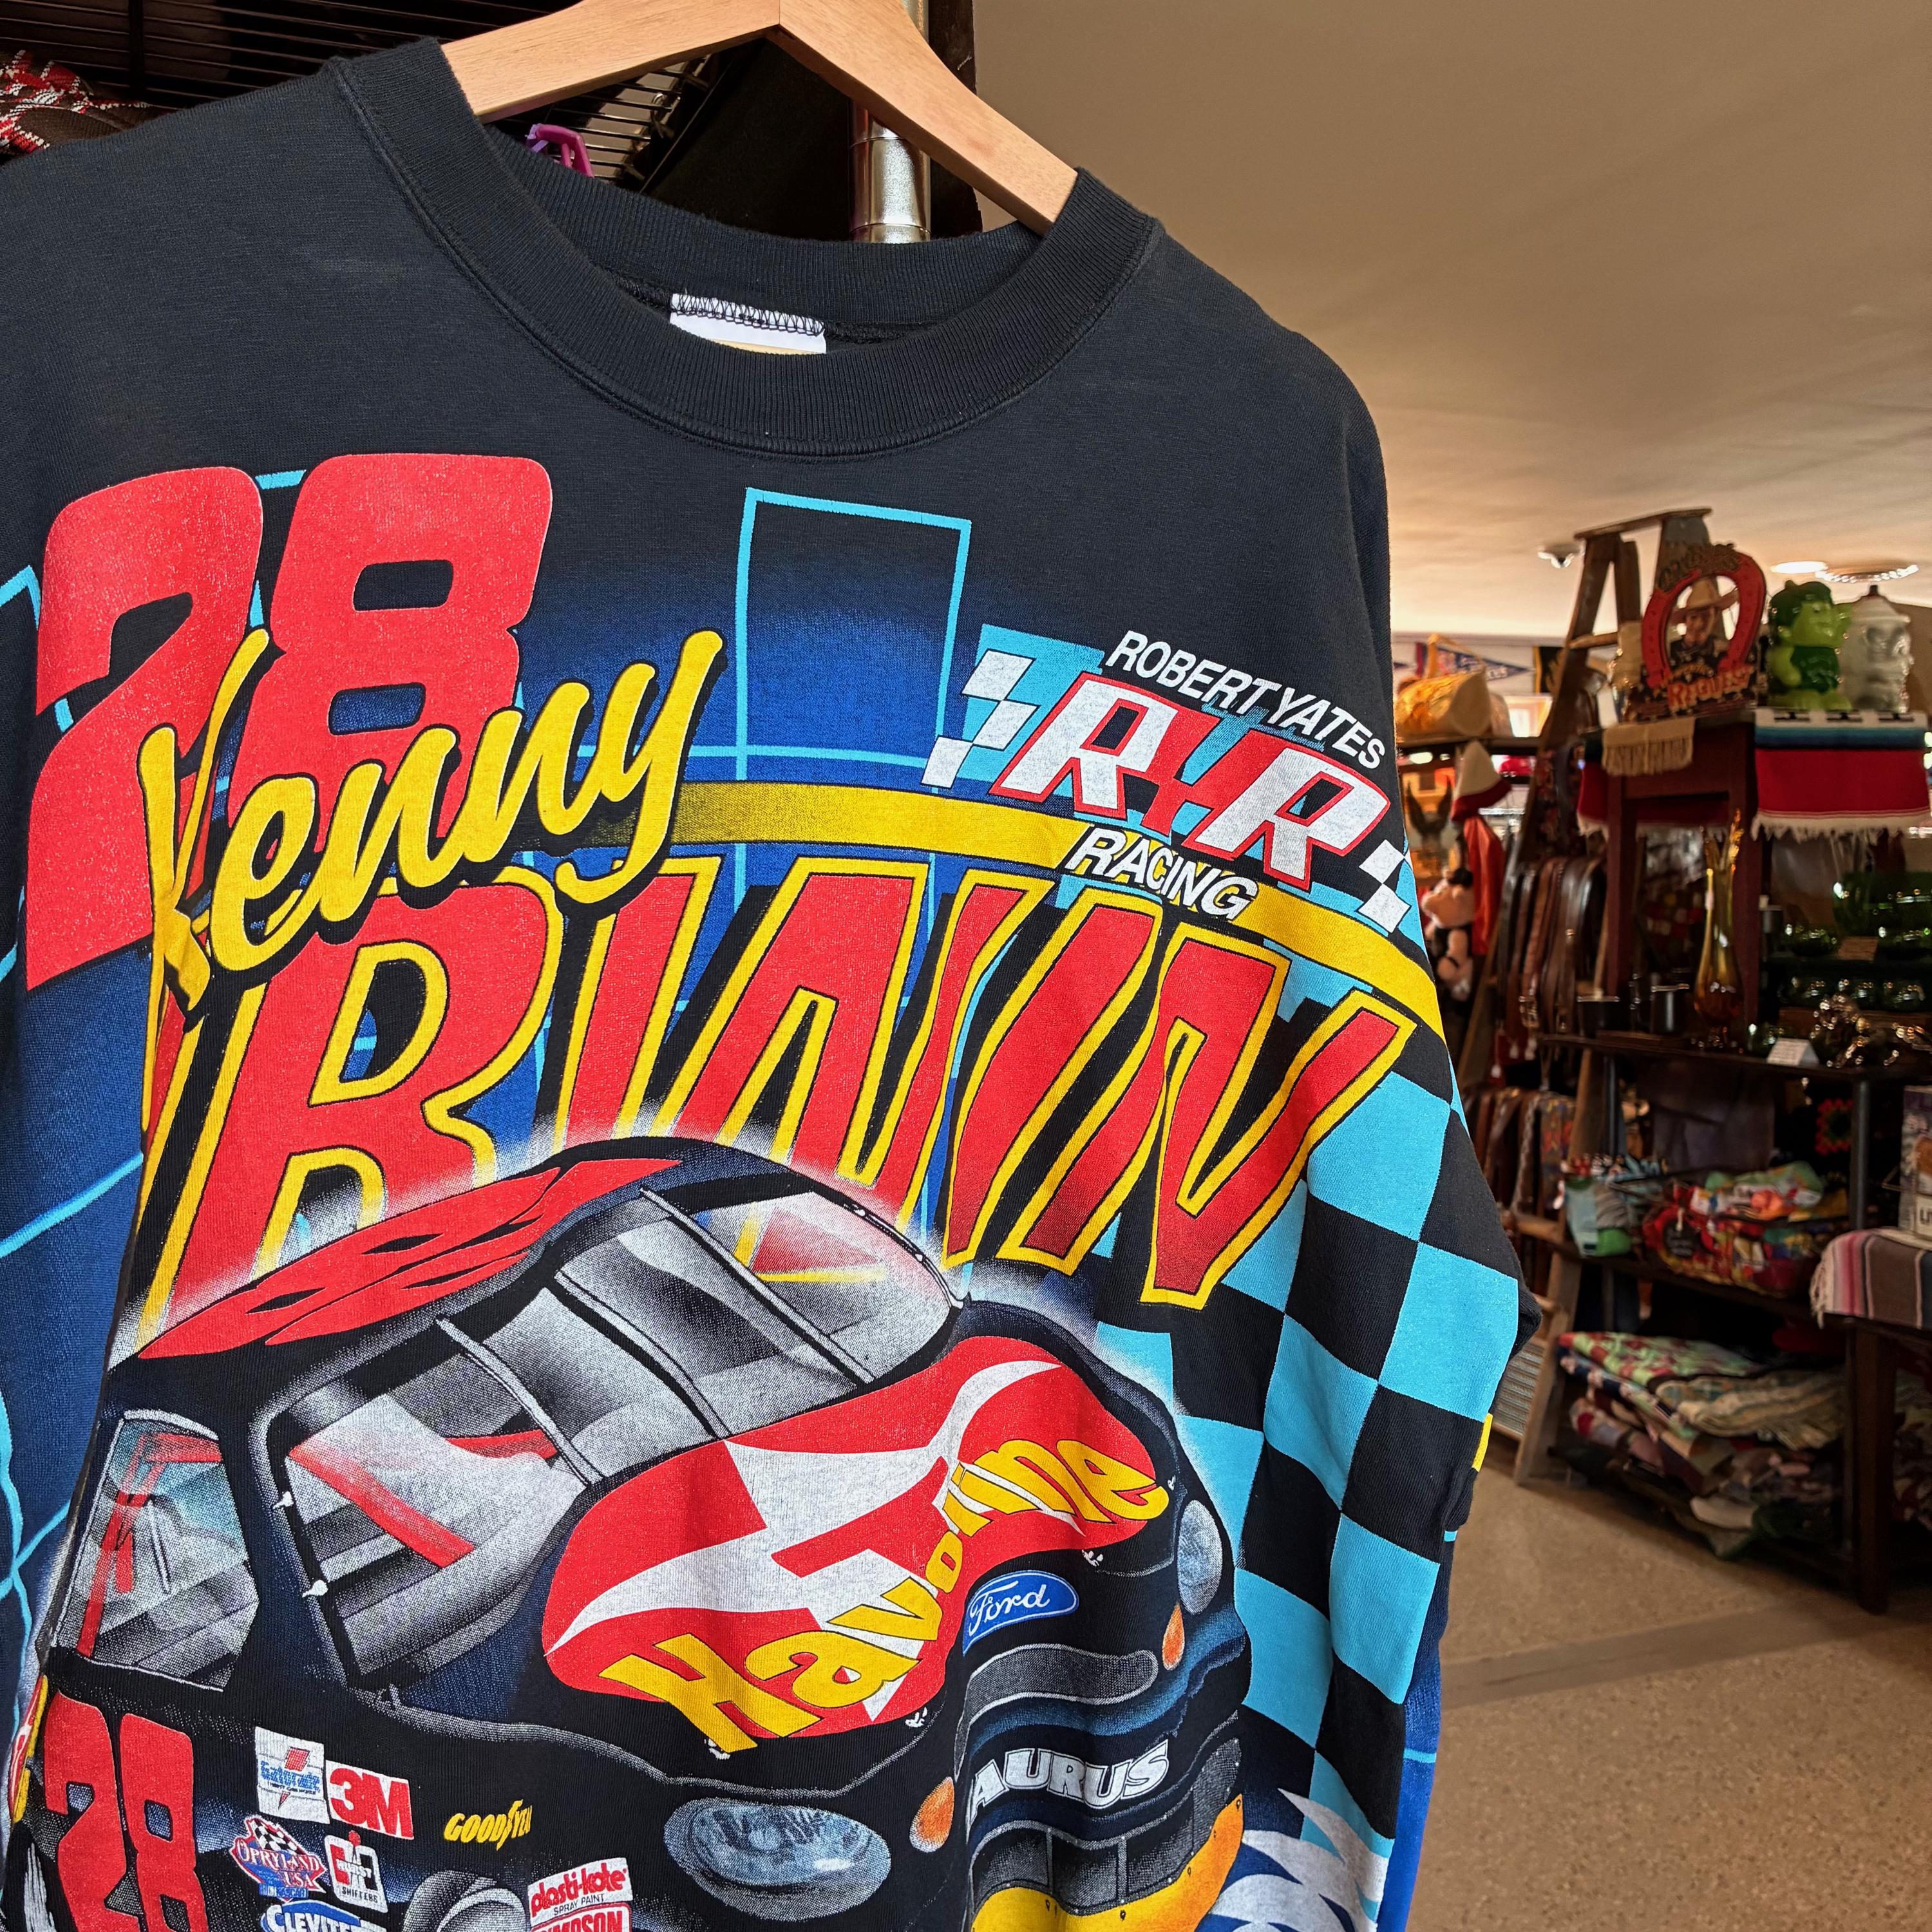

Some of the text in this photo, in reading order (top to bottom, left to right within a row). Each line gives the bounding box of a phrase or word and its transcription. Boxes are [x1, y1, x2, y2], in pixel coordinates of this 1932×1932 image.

[27, 453, 552, 991] 28
[1105, 630, 1386, 770] ROBERT YATES
[138, 629, 723, 1011] Kenny
[1065, 828, 1260, 920] RACING
[969, 1580, 1050, 1636] Ford
[44, 1692, 210, 1932] 28
[330, 1768, 413, 1839] 3M
[966, 1739, 1170, 1826] AURUS
[236, 1839, 320, 1872] OPRYLAND
[284, 1870, 314, 1888] USA
[341, 1886, 379, 1904] SHIFTERS
[540, 1911, 623, 1932] PSON
[553, 1893, 605, 1916] SPRAY PAINT
